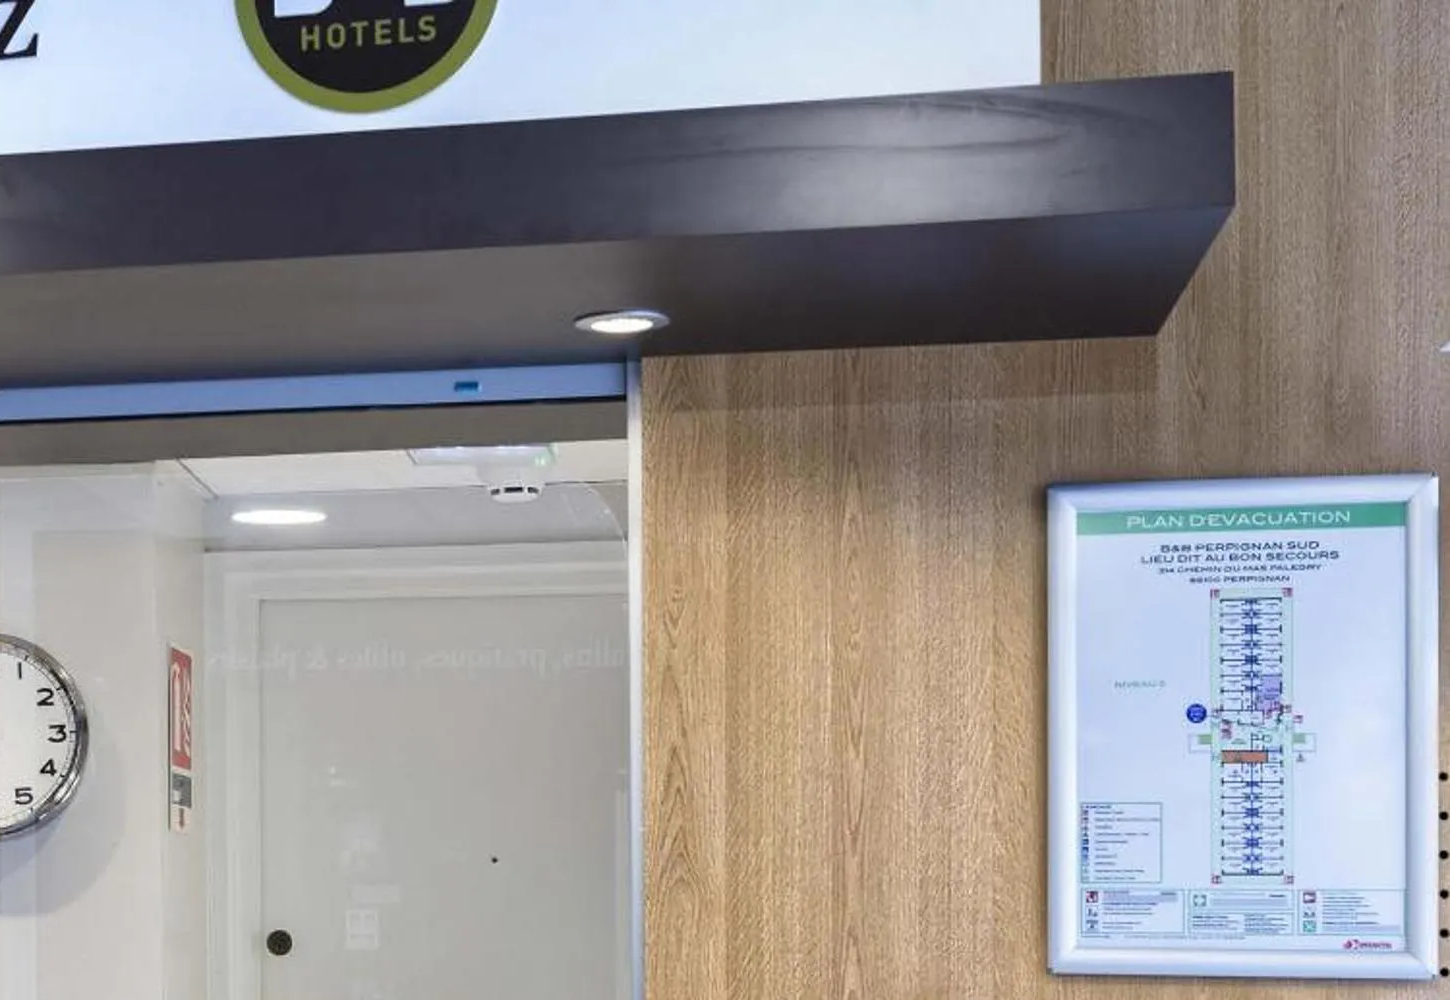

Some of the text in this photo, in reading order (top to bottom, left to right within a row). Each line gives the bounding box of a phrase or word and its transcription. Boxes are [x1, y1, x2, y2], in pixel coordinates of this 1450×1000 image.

[301, 15, 437, 52] HOTELS
[1126, 514, 1183, 529] PLAN
[1194, 541, 1283, 552] PERPIGNAN
[1287, 540, 1320, 550] SUD
[1140, 550, 1340, 564] LIEU DIT AU BON SECOURS
[36, 687, 55, 706] 2
[48, 724, 67, 743] 3
[40, 758, 57, 776] 4
[14, 786, 34, 806] 5
